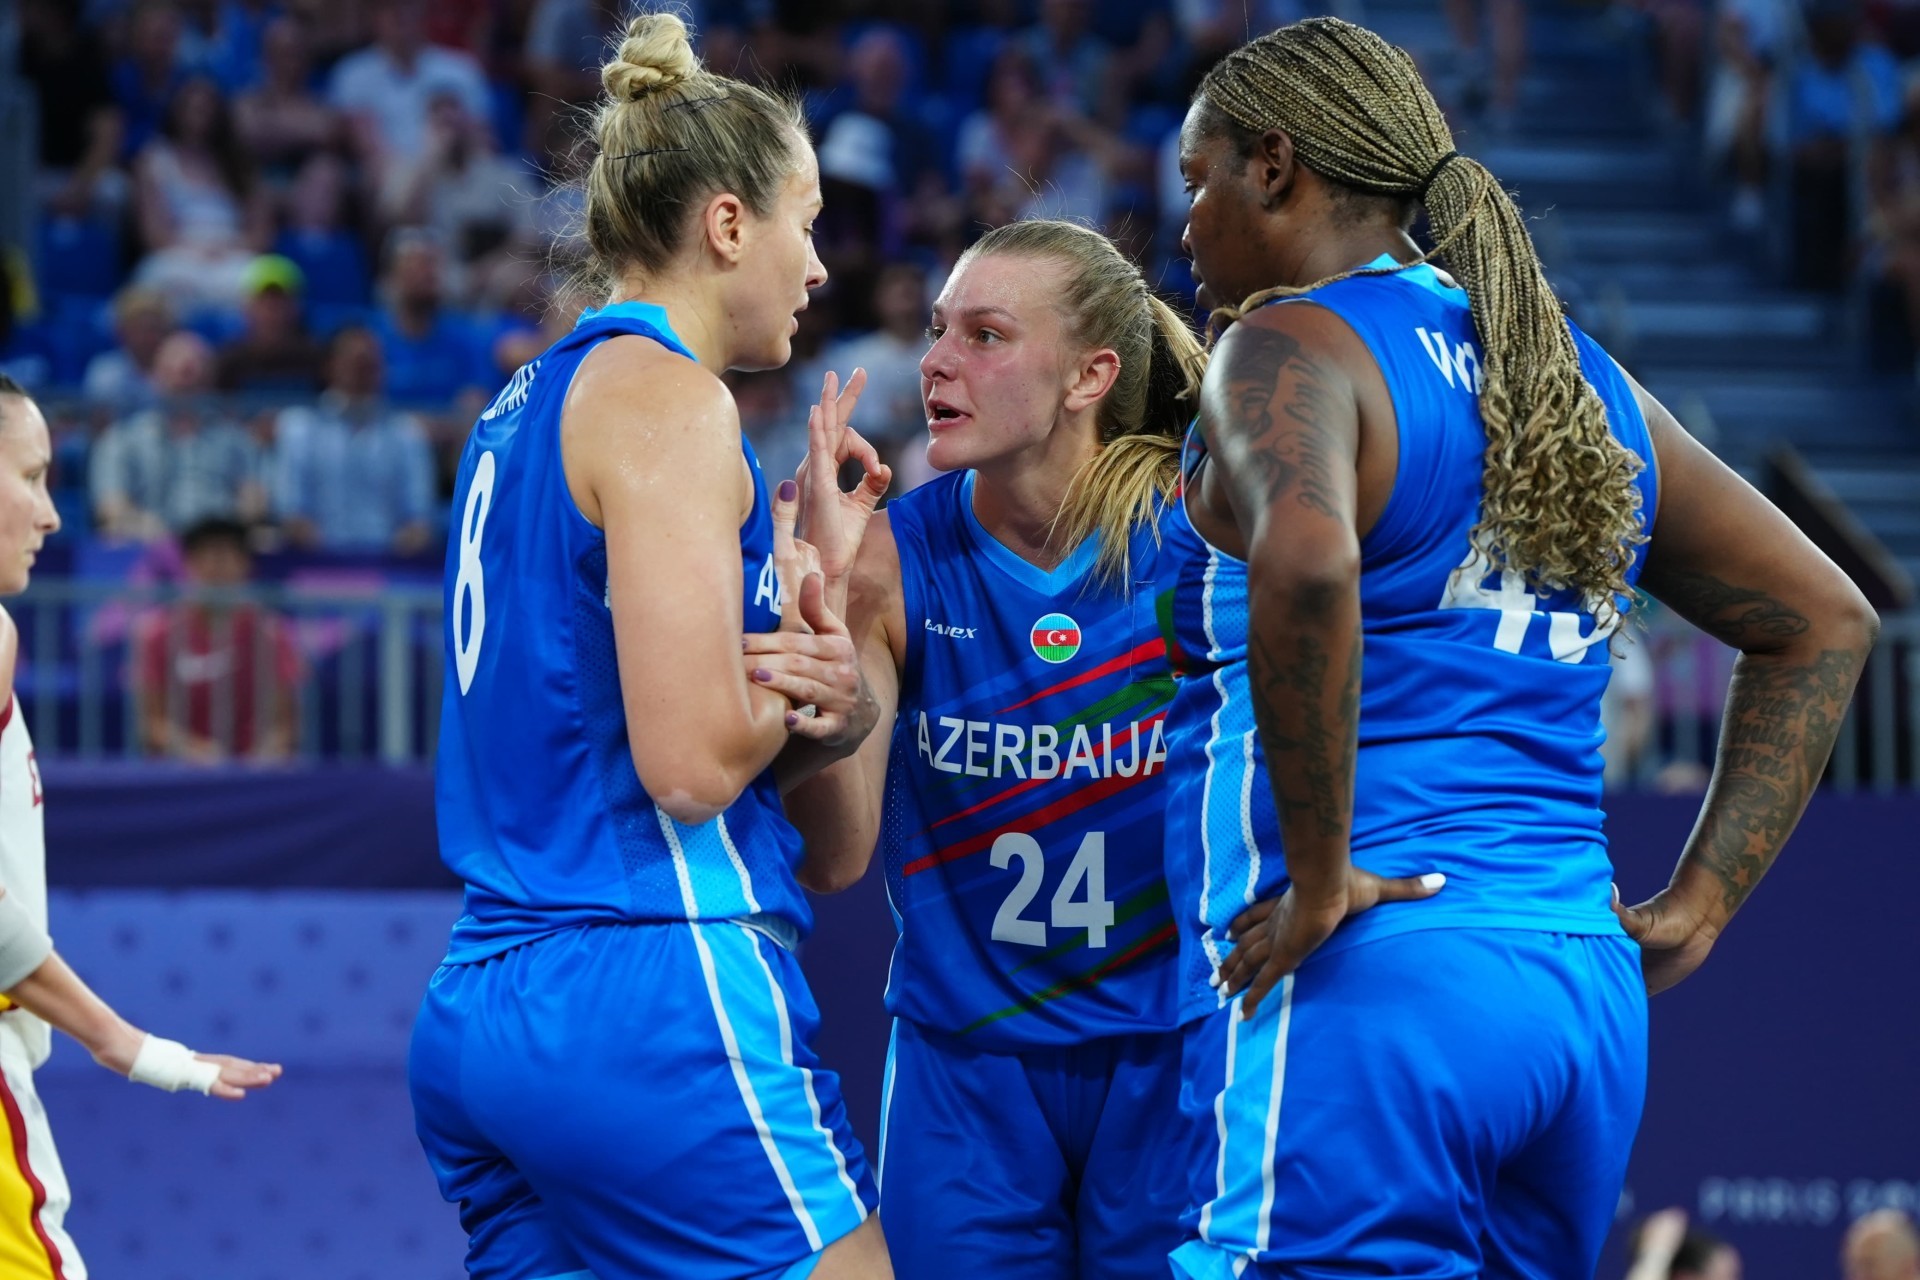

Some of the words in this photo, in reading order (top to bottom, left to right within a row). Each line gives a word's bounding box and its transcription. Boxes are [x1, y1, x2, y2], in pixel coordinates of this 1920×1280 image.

[453, 450, 496, 697] 8
[917, 710, 1168, 780] AZERBAIJA
[989, 831, 1115, 949] 24
